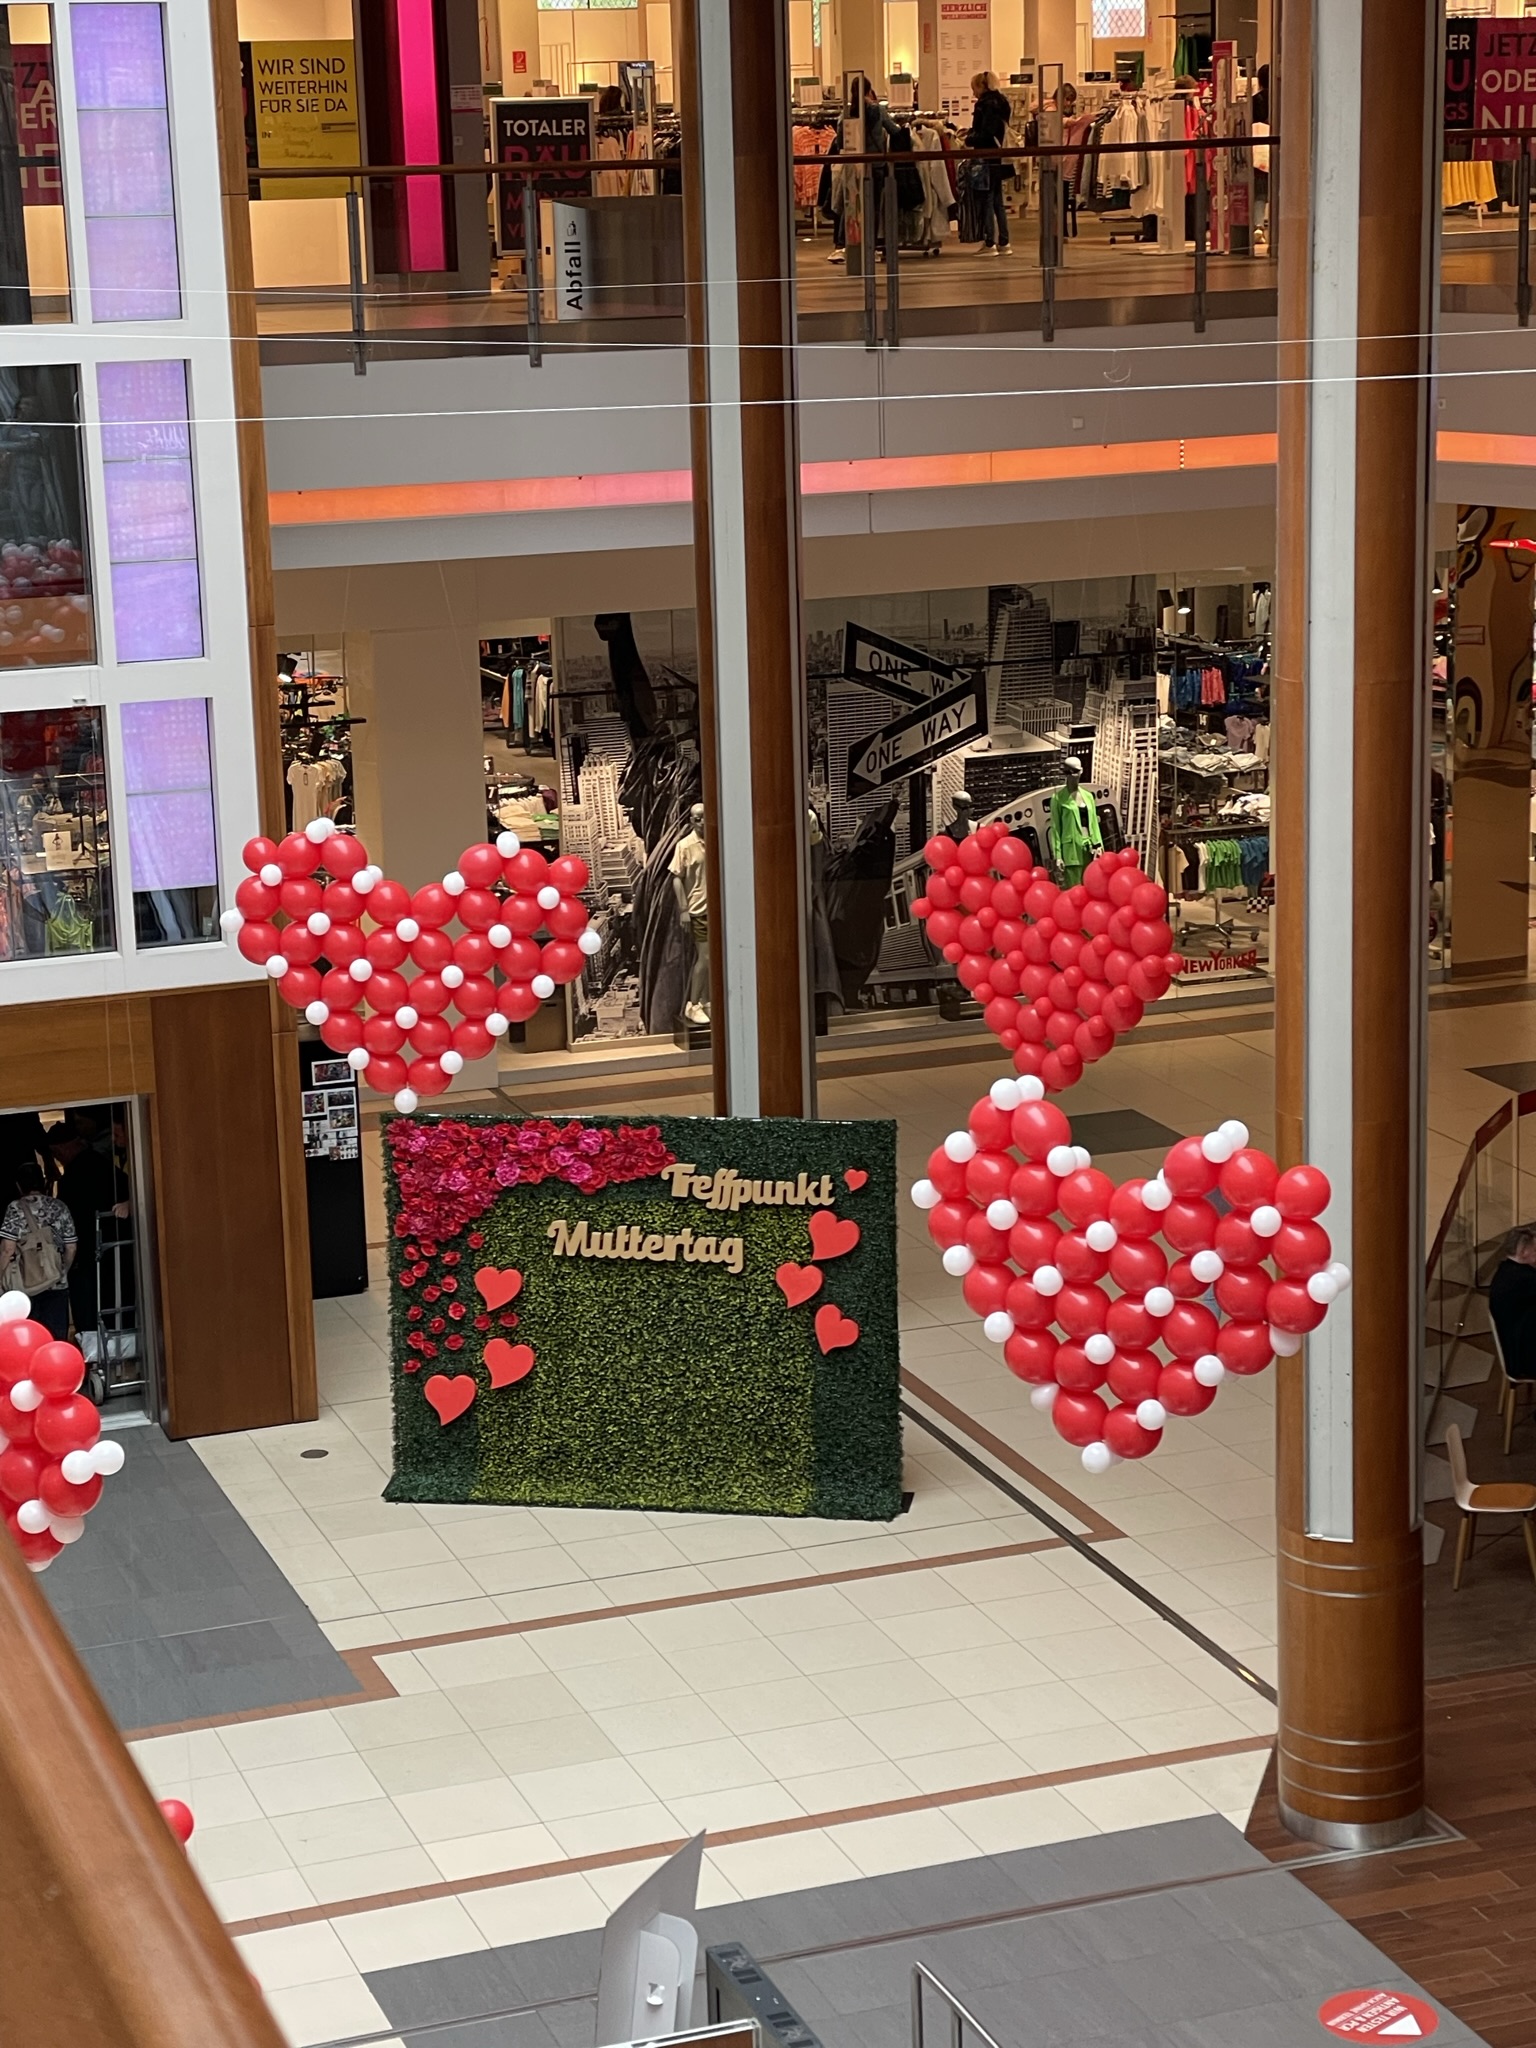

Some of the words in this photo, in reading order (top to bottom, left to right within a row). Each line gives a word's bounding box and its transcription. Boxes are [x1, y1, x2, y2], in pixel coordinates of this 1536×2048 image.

[257, 59, 294, 75] WIR
[300, 58, 346, 75] SIND
[258, 79, 348, 95] WEITERHIN
[260, 98, 292, 113] FÜR
[296, 99, 320, 113] SIE
[324, 98, 348, 112] DA
[503, 119, 586, 137] TOTALER
[504, 144, 588, 181] RÄU
[564, 242, 583, 311] Abfall
[869, 650, 911, 686] ONE
[866, 736, 902, 774] ONE
[922, 702, 966, 746] WAY
[661, 1163, 836, 1211] Treffpunkt
[547, 1219, 744, 1274] Muttertag
